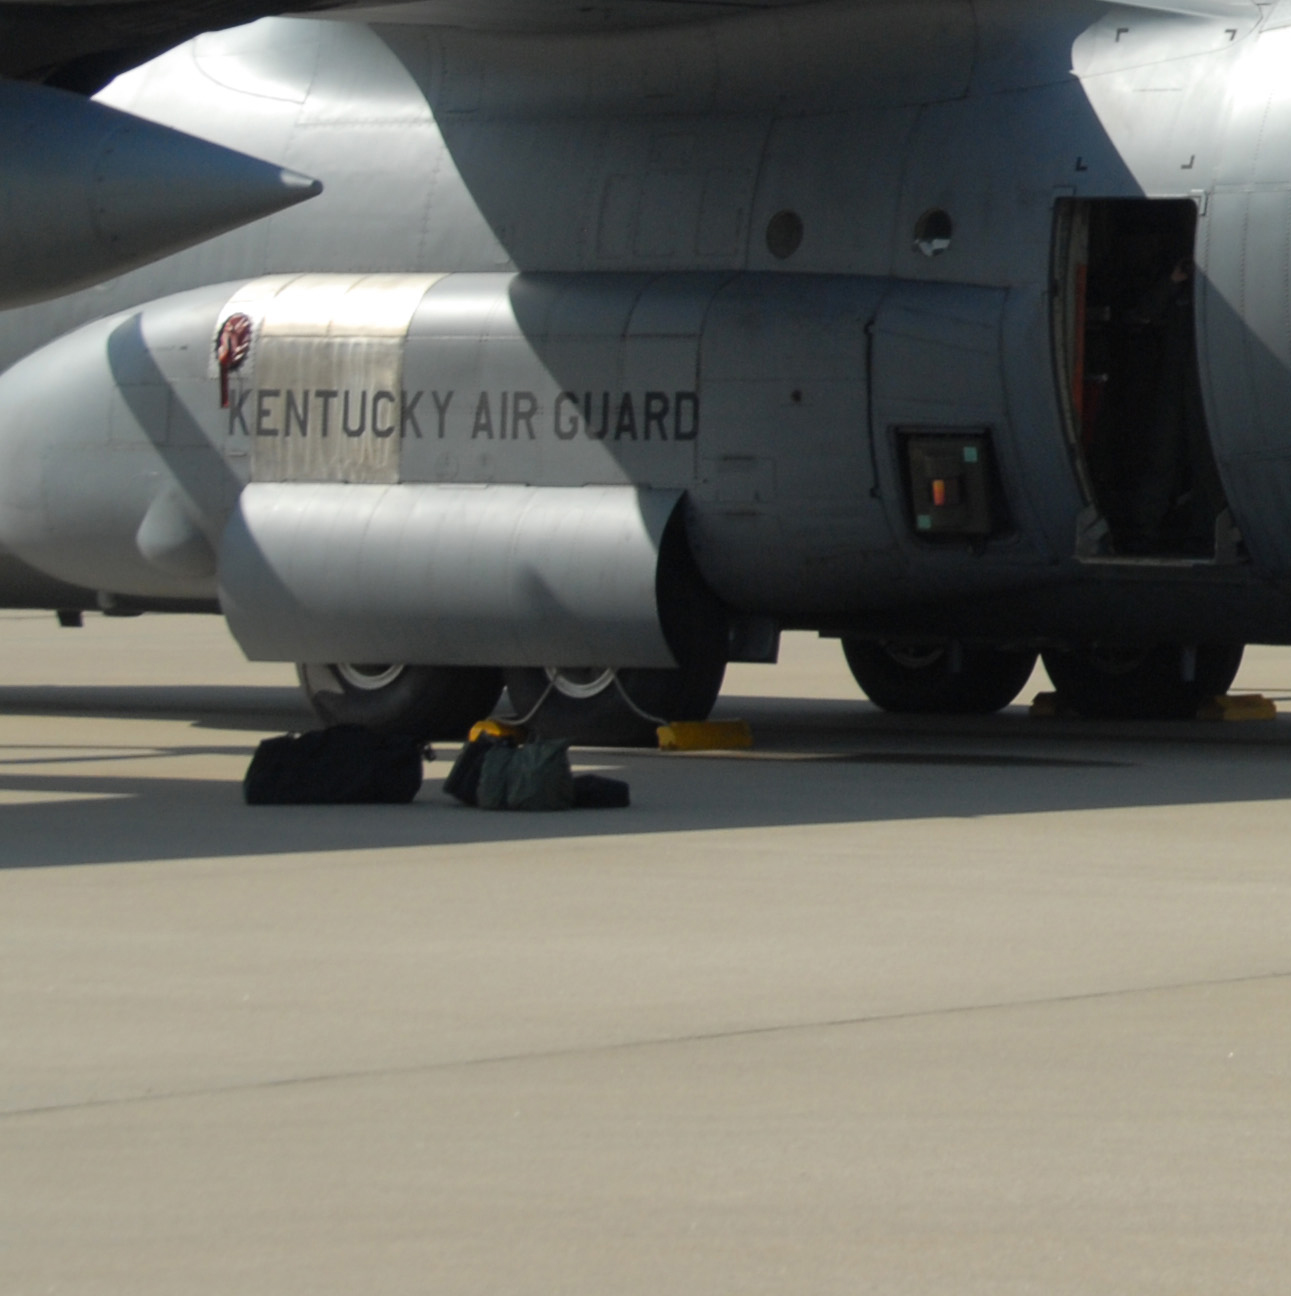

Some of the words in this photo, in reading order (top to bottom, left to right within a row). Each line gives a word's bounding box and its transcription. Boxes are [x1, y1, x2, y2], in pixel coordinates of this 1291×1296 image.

[228, 388, 454, 439] KENTUCKY
[470, 390, 538, 440] AIR
[553, 390, 700, 441] GUARD
